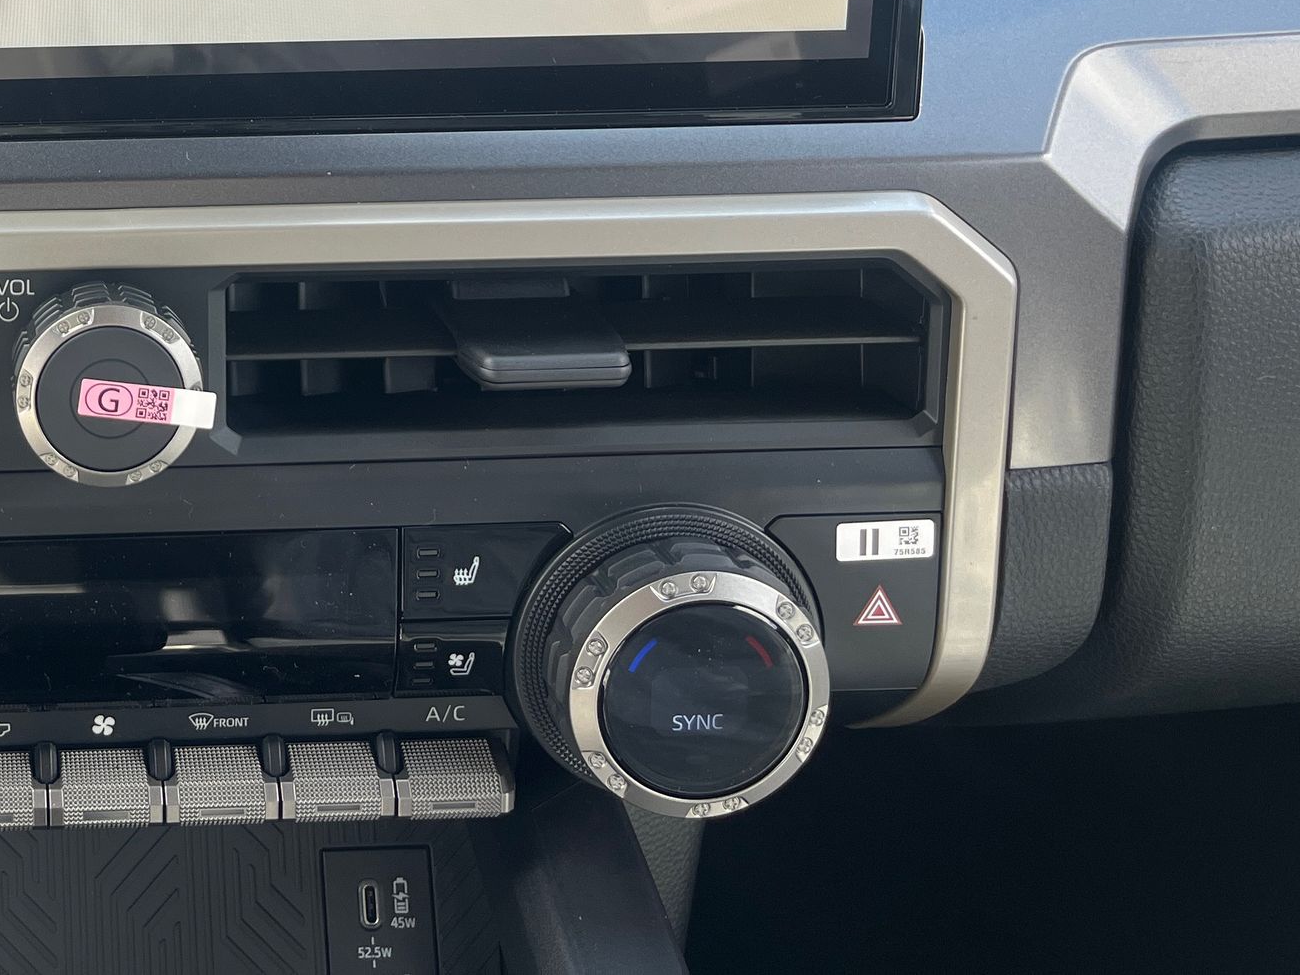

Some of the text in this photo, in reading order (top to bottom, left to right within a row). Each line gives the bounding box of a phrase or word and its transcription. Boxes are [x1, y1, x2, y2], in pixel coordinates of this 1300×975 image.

[97, 387, 122, 413] G
[425, 705, 467, 723] A/C
[213, 717, 249, 728] FRONT
[671, 714, 724, 731] SYNC
[390, 917, 416, 929] 45W
[357, 946, 392, 959] 52.5W
